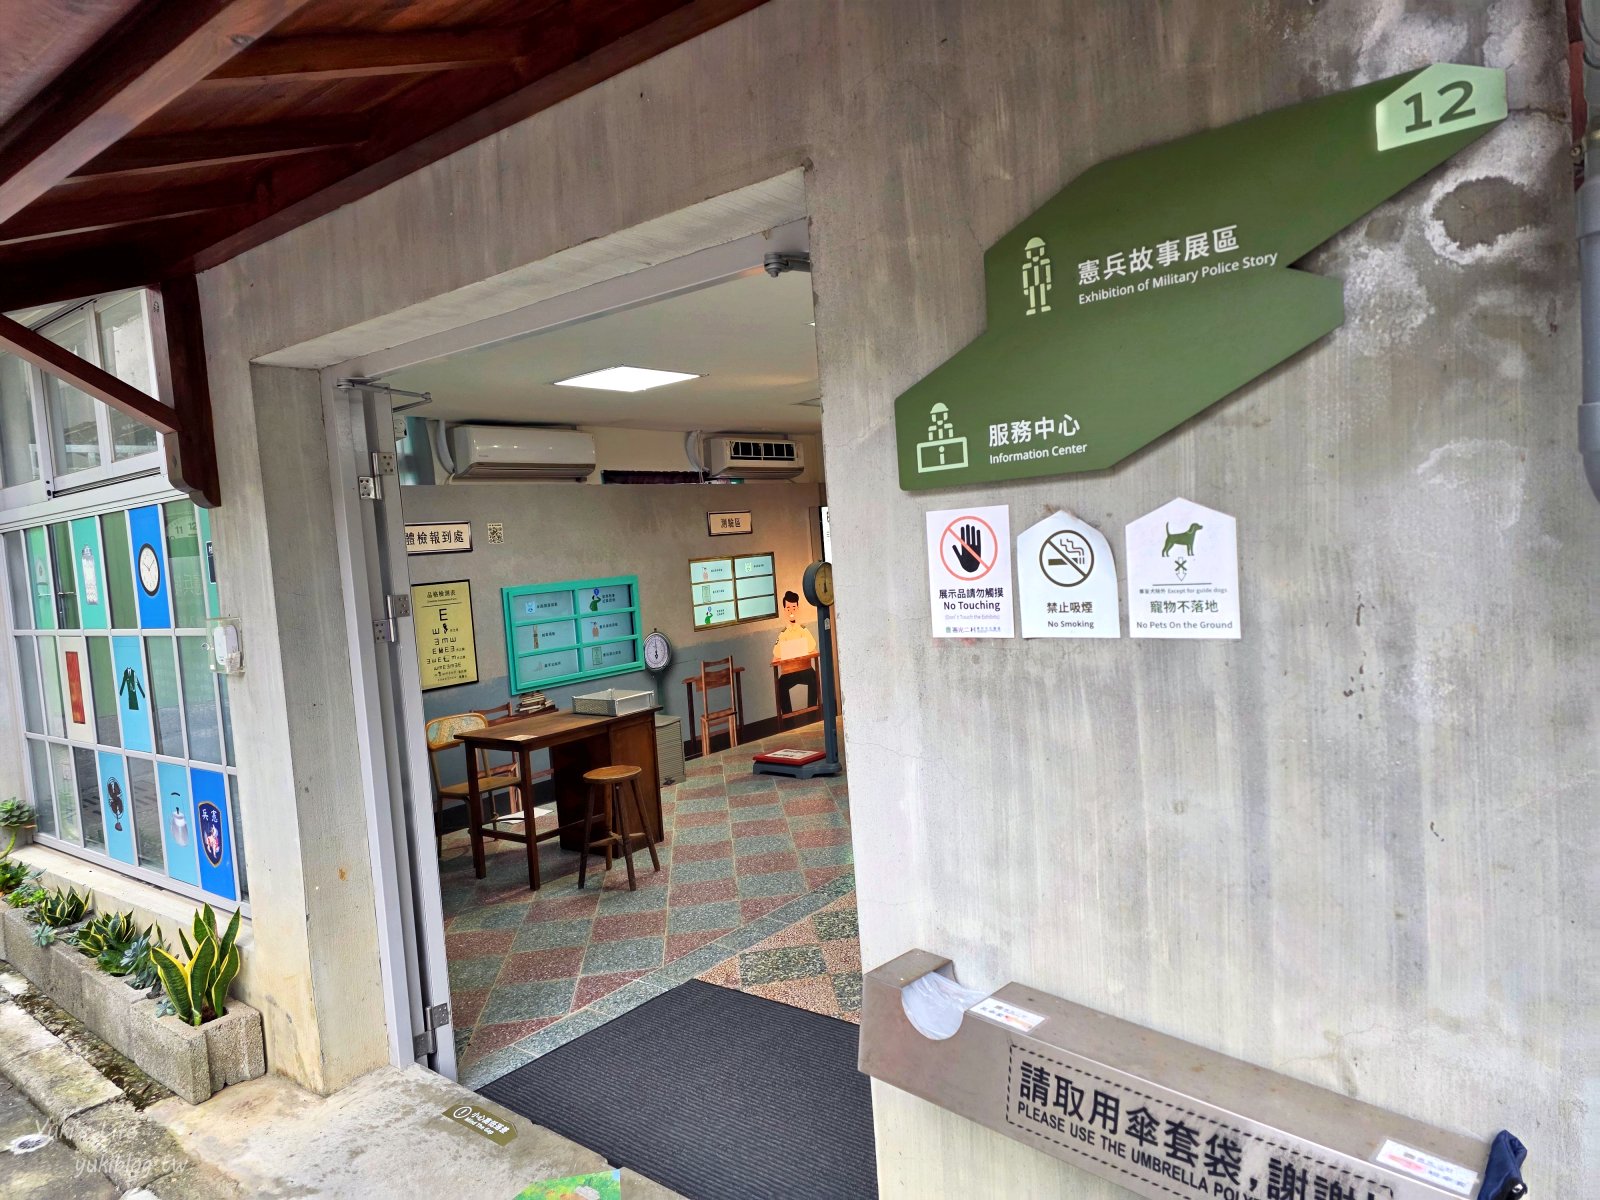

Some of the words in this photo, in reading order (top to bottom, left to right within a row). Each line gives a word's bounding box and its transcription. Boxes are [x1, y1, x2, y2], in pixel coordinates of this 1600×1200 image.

[1403, 80, 1476, 133] 12
[1078, 224, 1240, 286] 憲兵故事展區
[1078, 285, 1135, 304] Exhibition
[1137, 279, 1150, 292] of
[1152, 270, 1199, 289] Military
[1202, 260, 1239, 278] Police
[1242, 252, 1278, 269] Story
[989, 413, 1080, 447] 服務中心
[989, 447, 1049, 464] Information
[1051, 443, 1088, 456] Center
[939, 587, 1004, 599] 展示品請勿觸摸
[943, 601, 956, 610] No
[958, 600, 1001, 612] Touching
[1046, 601, 1093, 613] 禁止吸煙
[1150, 600, 1219, 613] 寵物不落地
[1047, 620, 1059, 628] No
[1060, 620, 1094, 629] Smoking
[1136, 621, 1148, 629] No
[1149, 621, 1167, 629] Pets
[1169, 621, 1181, 629] On
[1183, 621, 1198, 629] the
[1200, 621, 1233, 629] Ground
[1017, 1101, 1066, 1134] PLEASE
[1069, 1123, 1096, 1146] USE
[1100, 1134, 1126, 1159] THE
[1131, 1148, 1209, 1193] UMBRELLA
